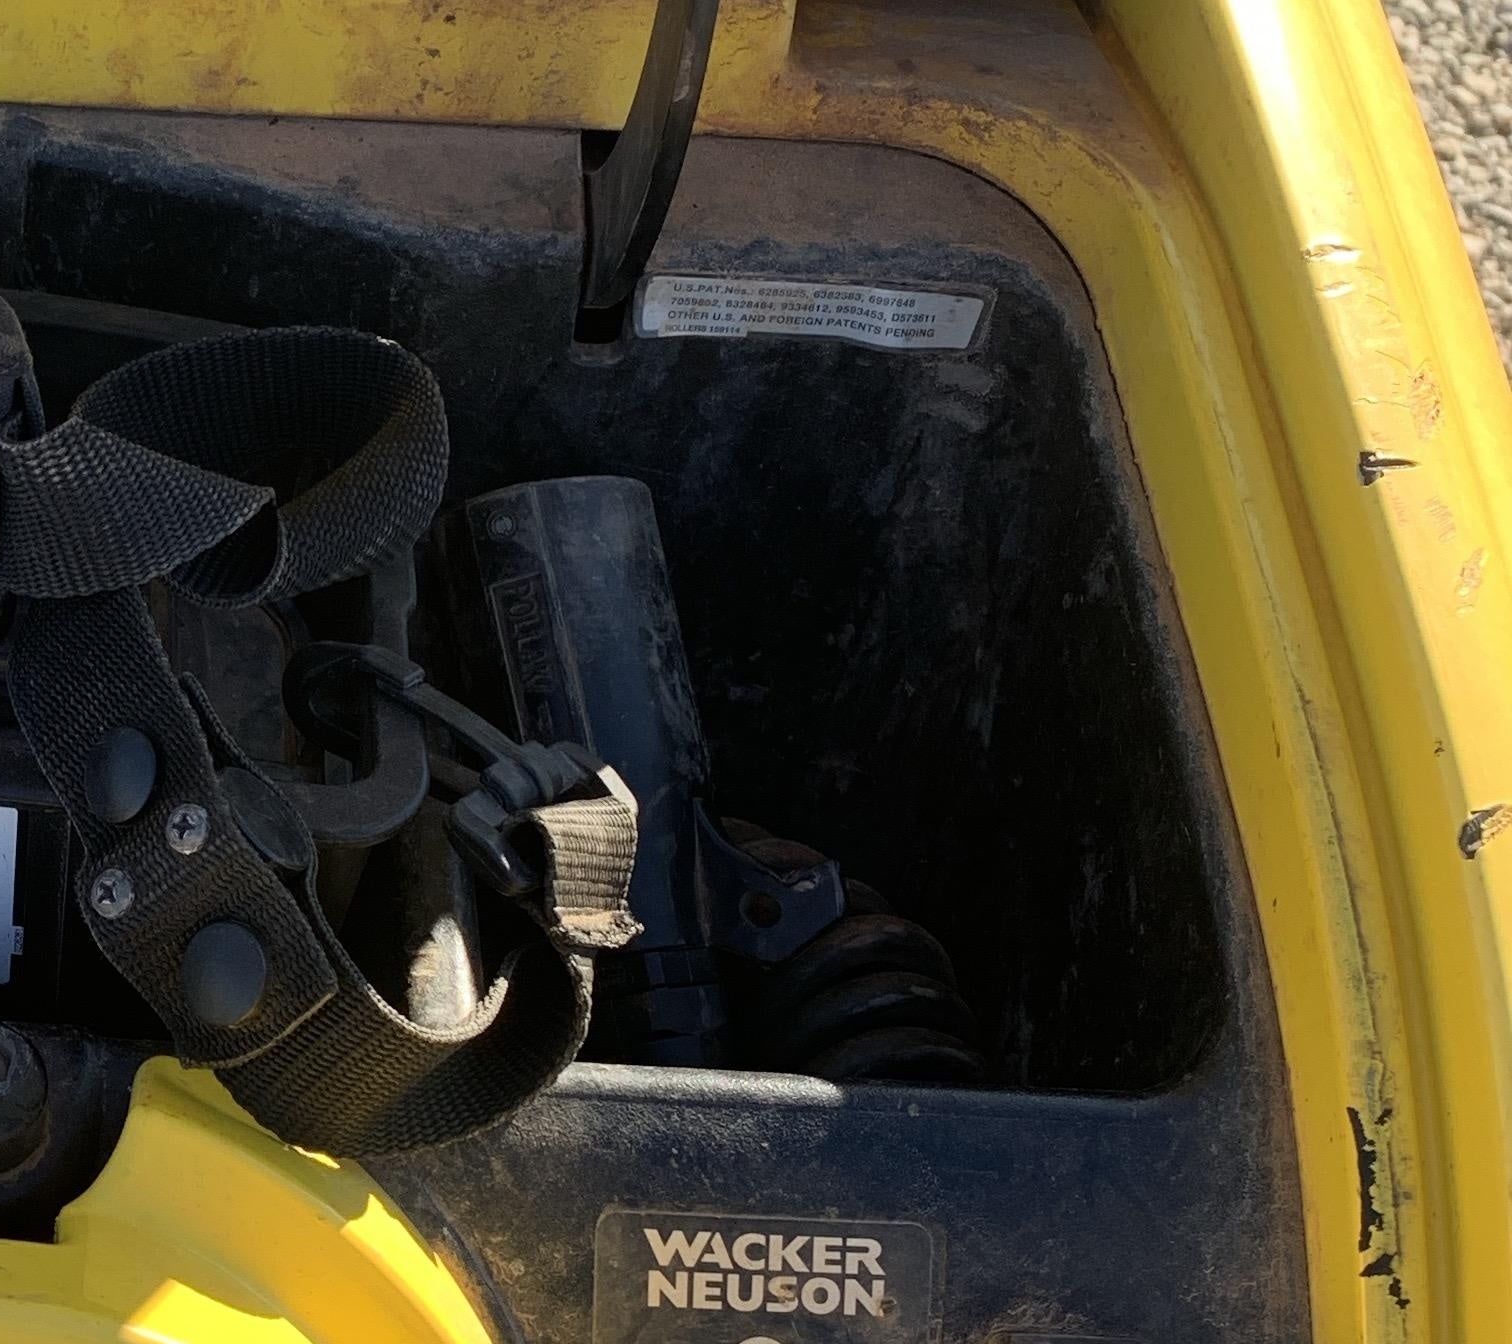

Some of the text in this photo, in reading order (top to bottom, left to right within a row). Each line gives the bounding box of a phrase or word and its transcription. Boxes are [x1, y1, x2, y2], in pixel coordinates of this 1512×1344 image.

[668, 310, 935, 338] OTHER U.S. AND FOREIGN PATENTS PENDING
[643, 1227, 886, 1277] WACKER
[647, 1270, 886, 1318] NEUSON
